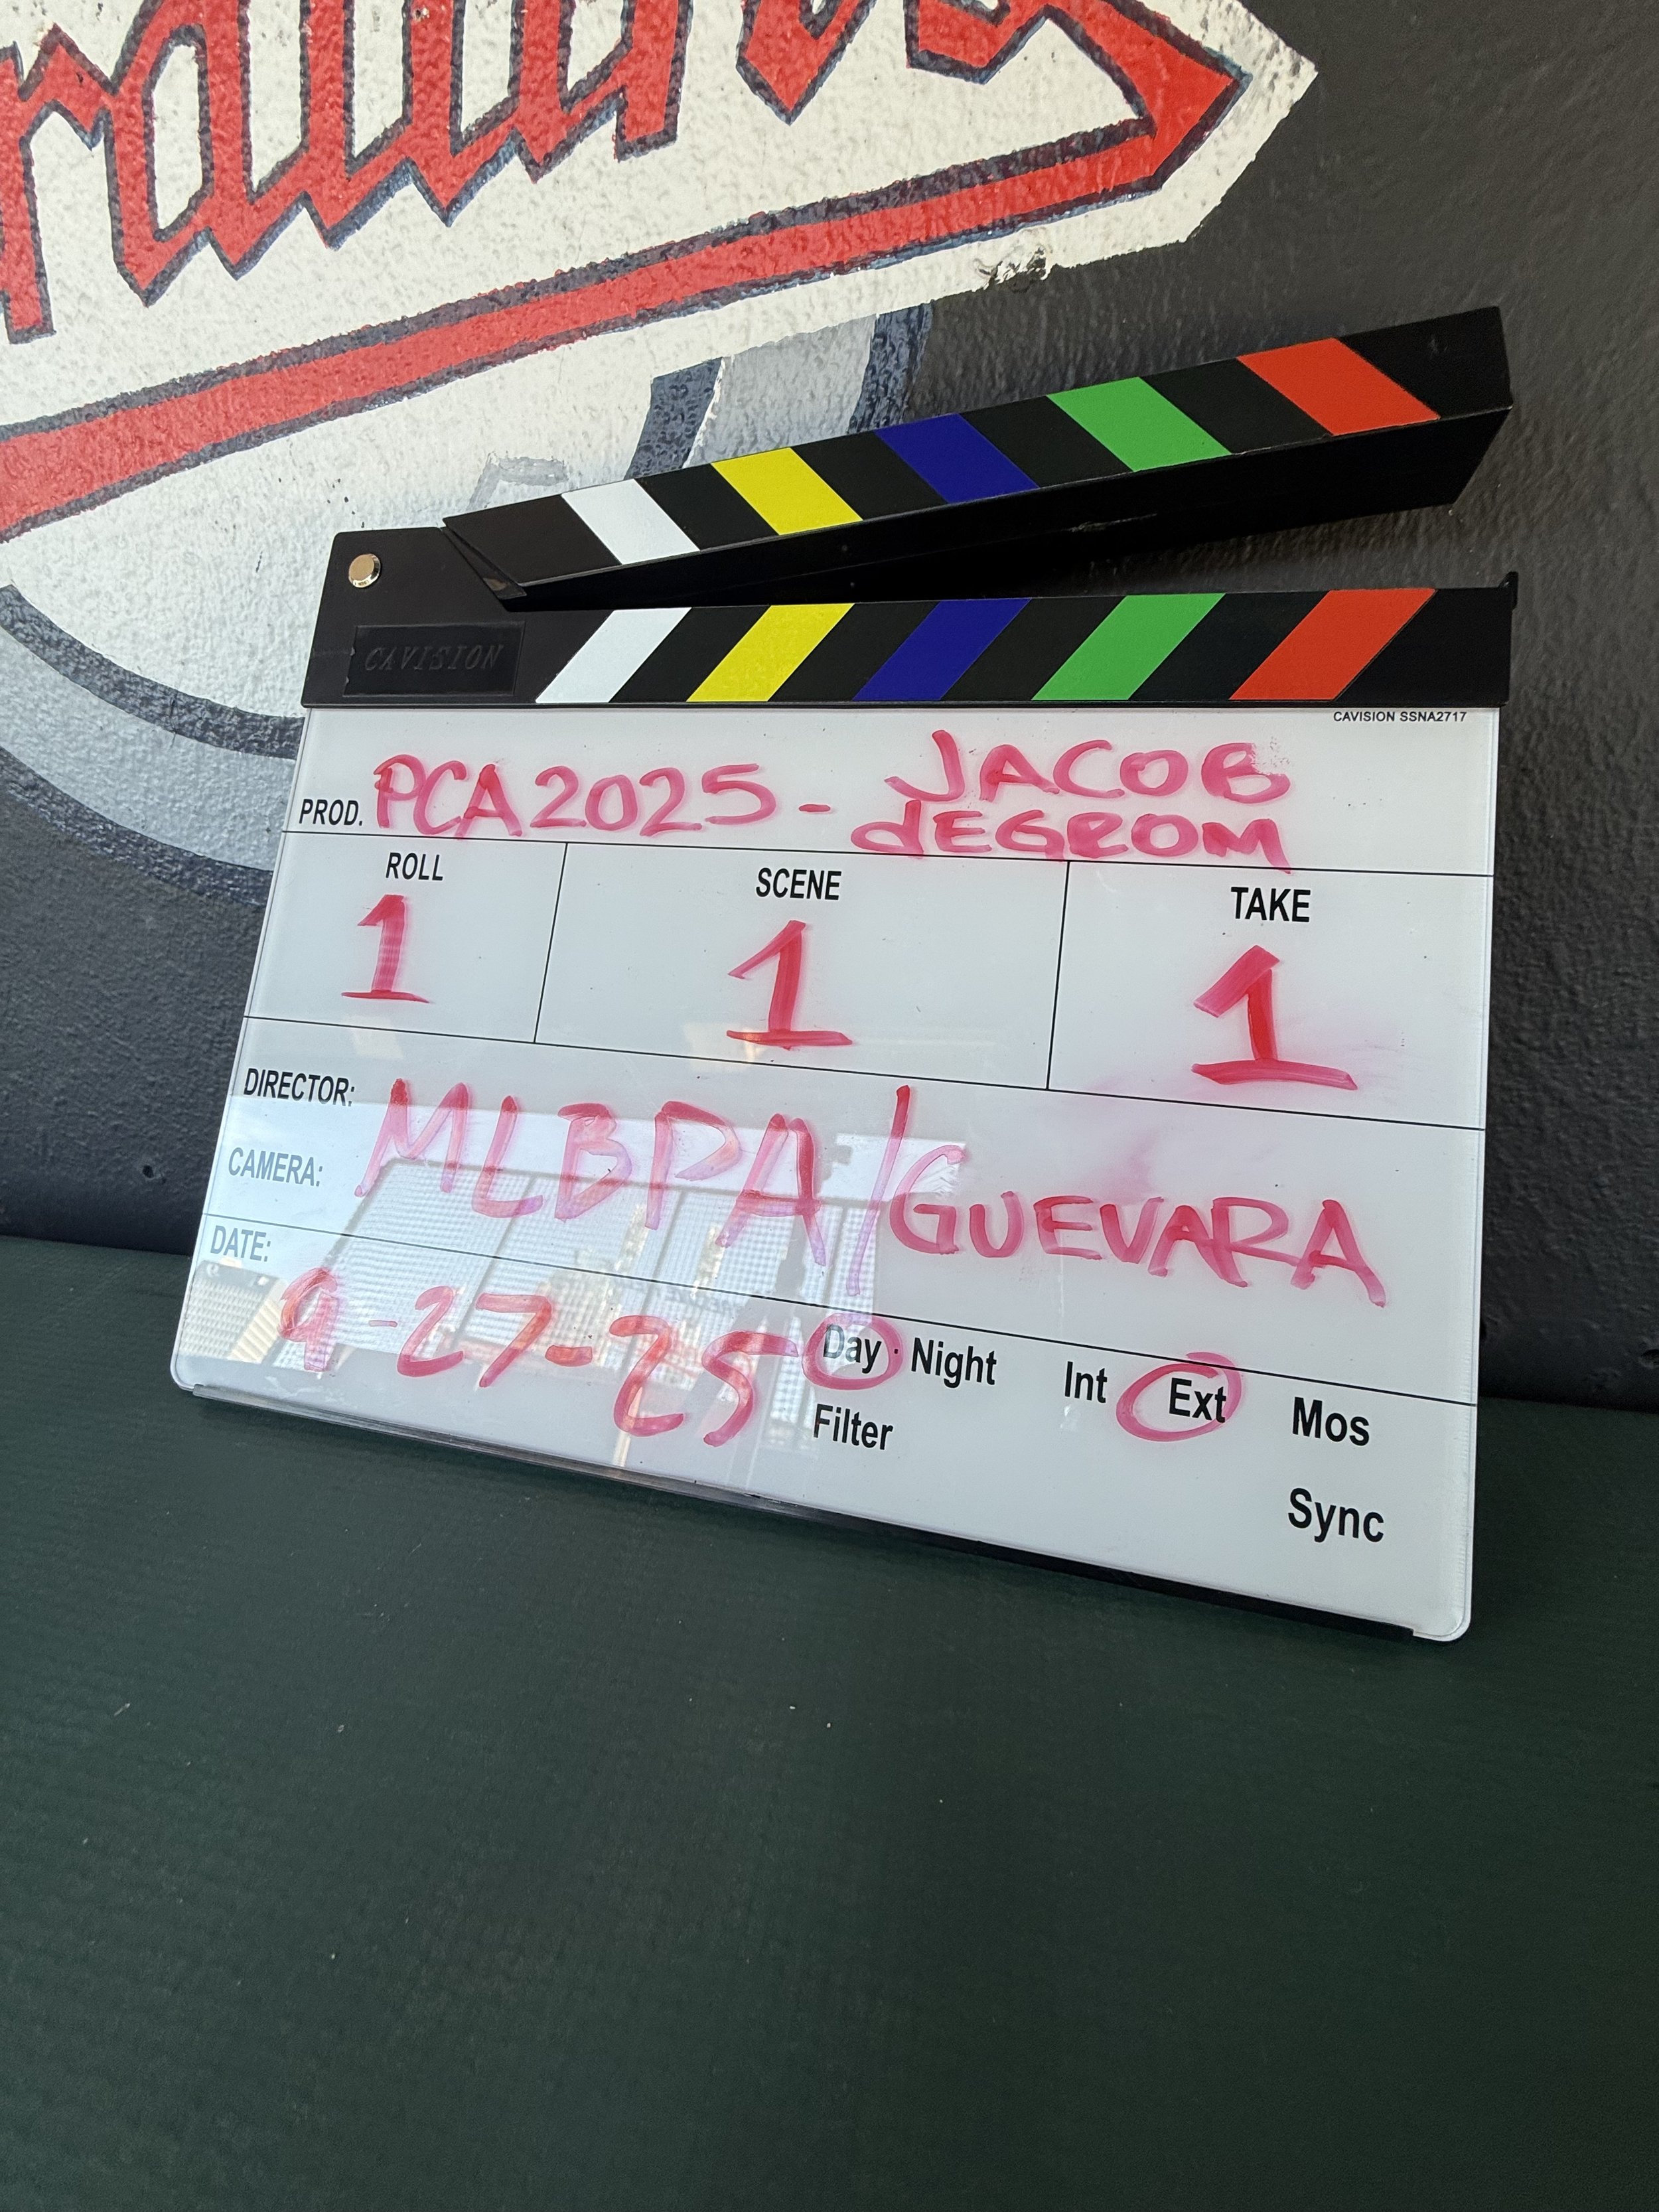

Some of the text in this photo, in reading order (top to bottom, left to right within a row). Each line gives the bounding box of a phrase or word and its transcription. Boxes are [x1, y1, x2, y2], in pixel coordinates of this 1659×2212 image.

[366, 643, 504, 671] CAVISION
[1333, 711, 1467, 723] CAVISION SSNA2717
[885, 729, 1291, 804] JACOB
[299, 798, 364, 826] PROD.
[385, 852, 444, 881] ROLL
[755, 867, 842, 901] SCENE
[1230, 887, 1311, 922] TAKE
[341, 893, 430, 1003] 1
[727, 920, 853, 1050] 1
[1192, 945, 1358, 1090] 1
[243, 1068, 355, 1107] DIRECTOR:
[228, 1147, 323, 1187] CAMERA:
[210, 1225, 271, 1262] DATE:
[823, 1324, 997, 1388] Day Night
[1064, 1361, 1227, 1424] Int Ext
[813, 1403, 894, 1450] Filter
[1292, 1396, 1370, 1446] Mos
[1287, 1487, 1385, 1543] Sync
